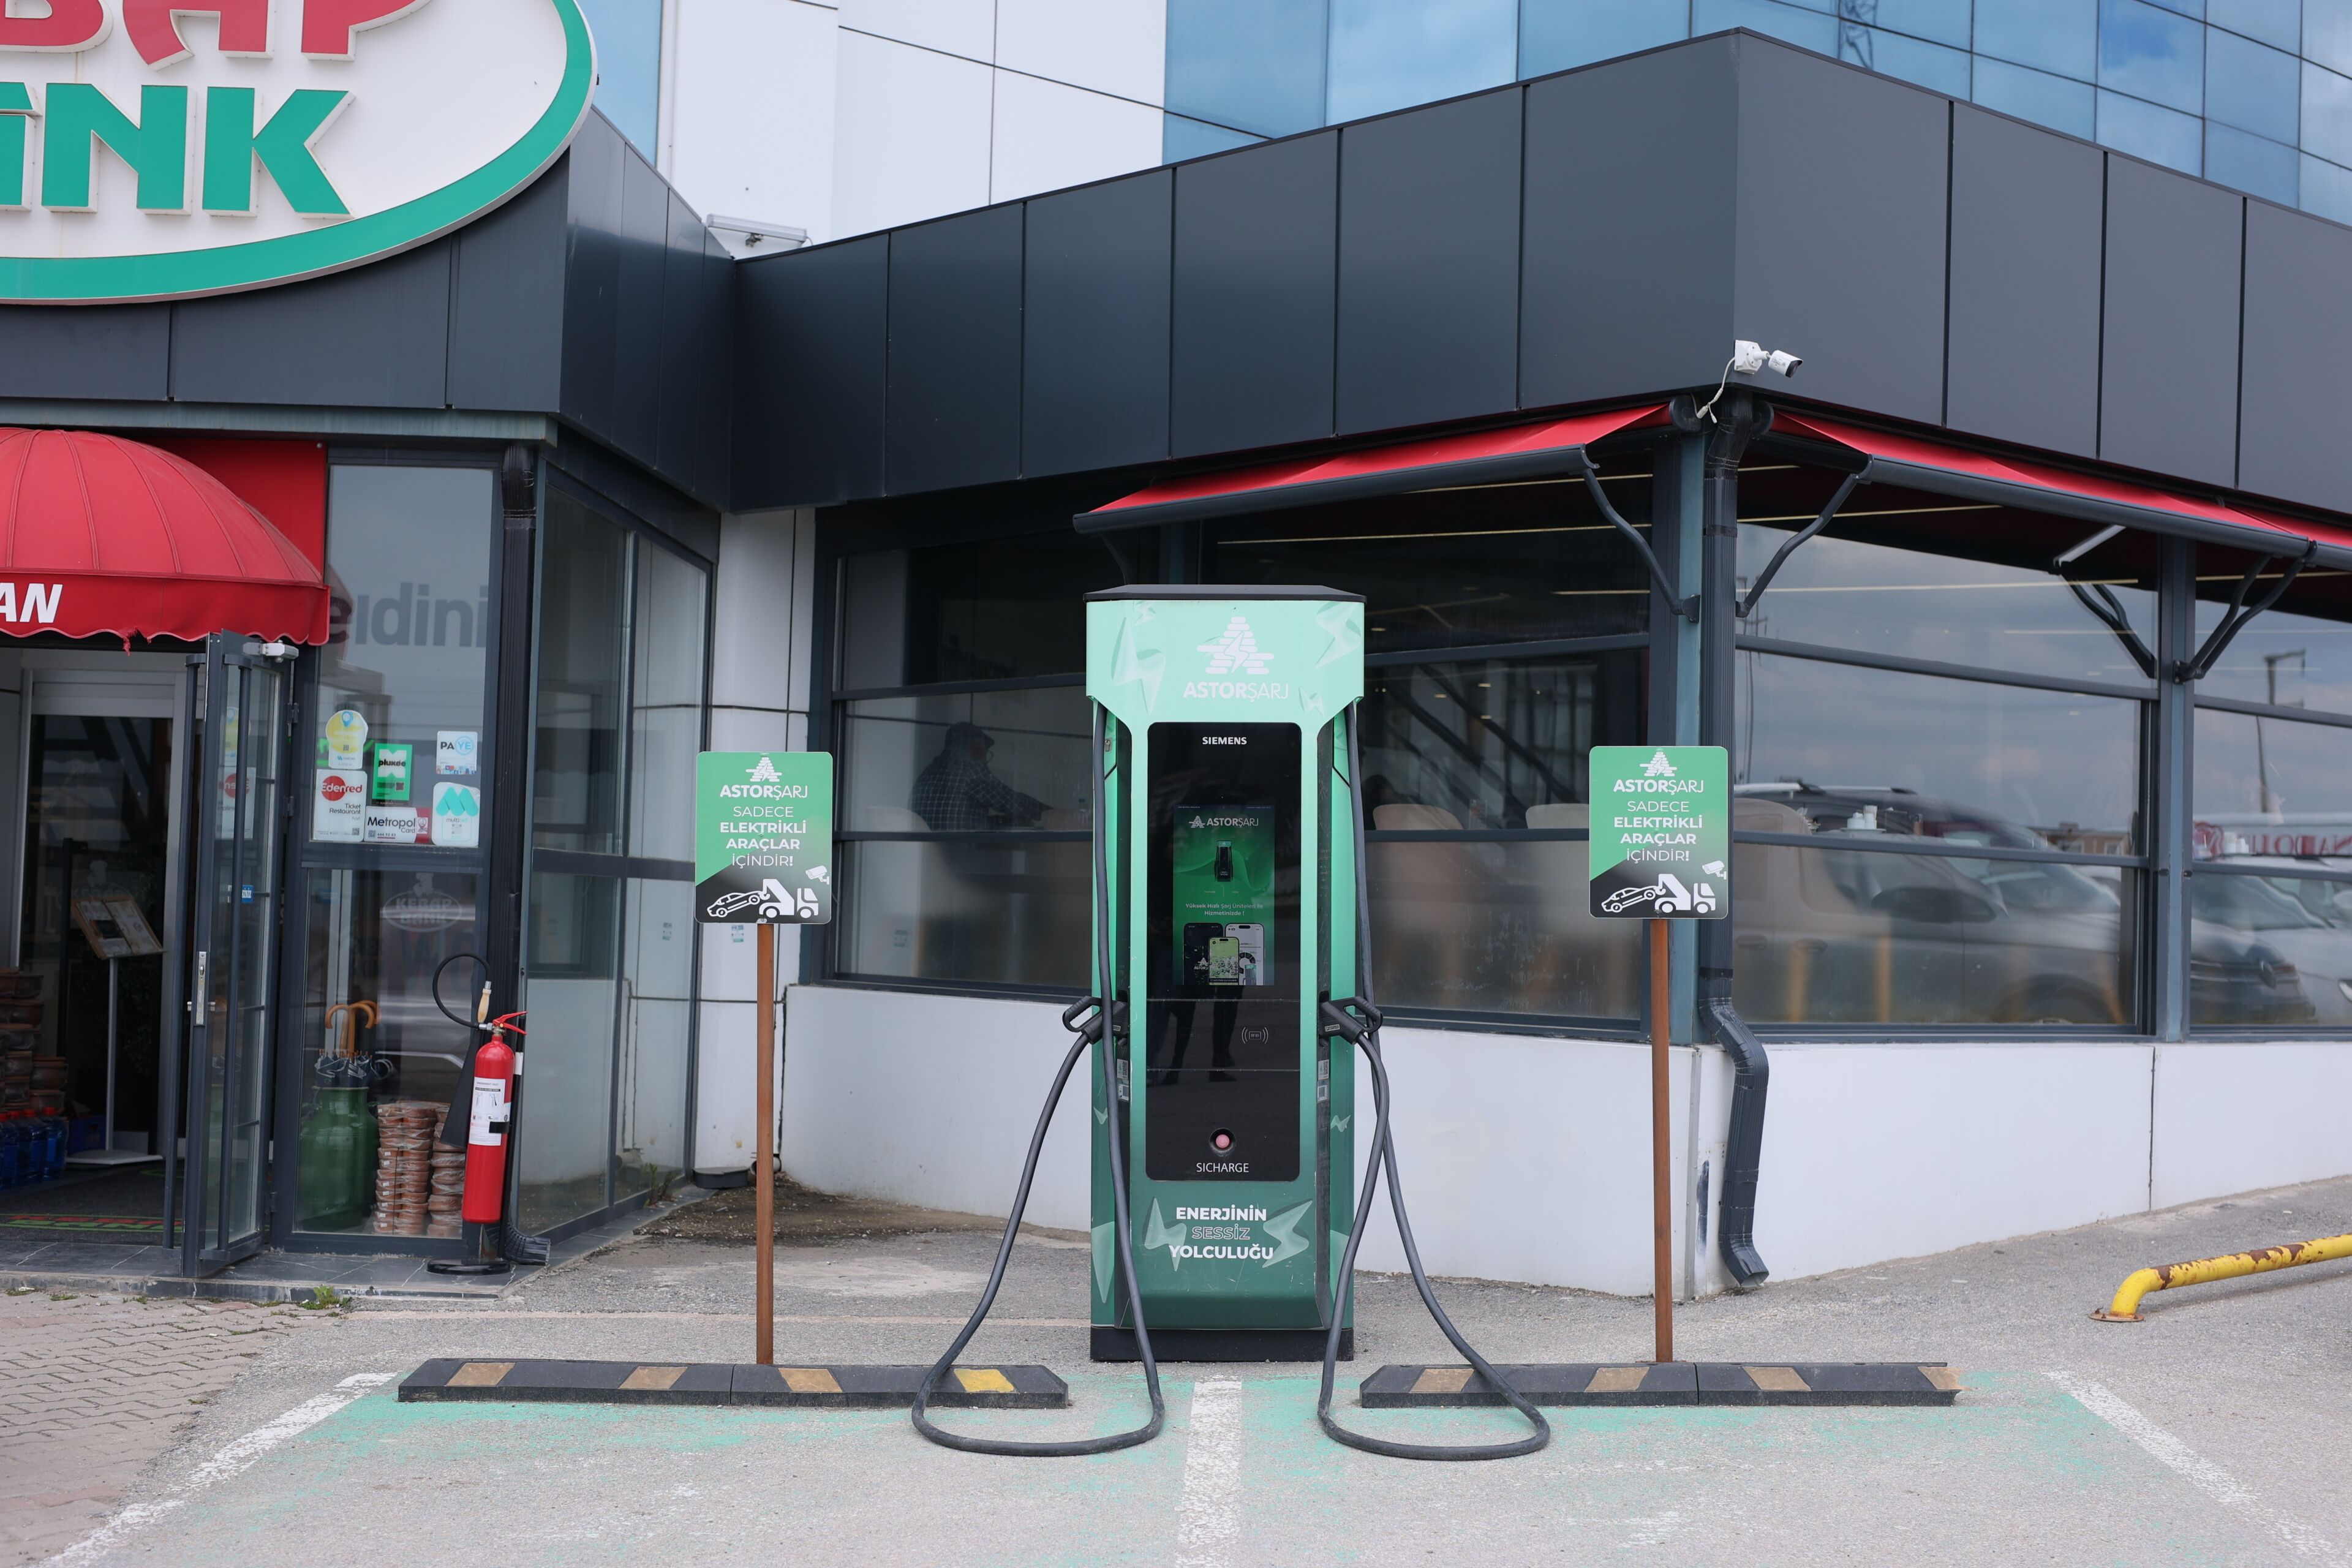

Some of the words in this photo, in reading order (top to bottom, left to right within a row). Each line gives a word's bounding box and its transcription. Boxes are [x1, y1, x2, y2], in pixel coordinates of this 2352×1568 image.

[0, 582, 63, 624] AN
[1183, 682, 1289, 702] ASTORŞARJ
[1202, 736, 1247, 745] SIEMENS
[322, 783, 363, 793] Edenred
[720, 785, 808, 801] ASTORŞARJ
[1613, 779, 1704, 794] ASTORŞARJ
[733, 806, 794, 818] SADECE
[1627, 801, 1690, 812] SADECE
[368, 816, 416, 829] Metropol
[720, 820, 806, 834] ELEKTRİKLİ
[1207, 817, 1259, 828] ASTORŞARJ
[1614, 815, 1702, 829] ELEKTRİKLİ
[726, 838, 801, 852] ARAÇLAR
[1620, 832, 1696, 846] ARAÇLAR
[731, 853, 794, 869] İÇİNDİR!
[1627, 848, 1689, 864] İÇİNDİR!
[1196, 1163, 1250, 1174] SICHARGE
[1176, 1205, 1267, 1221] ENERJİNİN
[1191, 1224, 1250, 1240] SESSİZ
[1169, 1244, 1274, 1260] YOLCULUĞU
